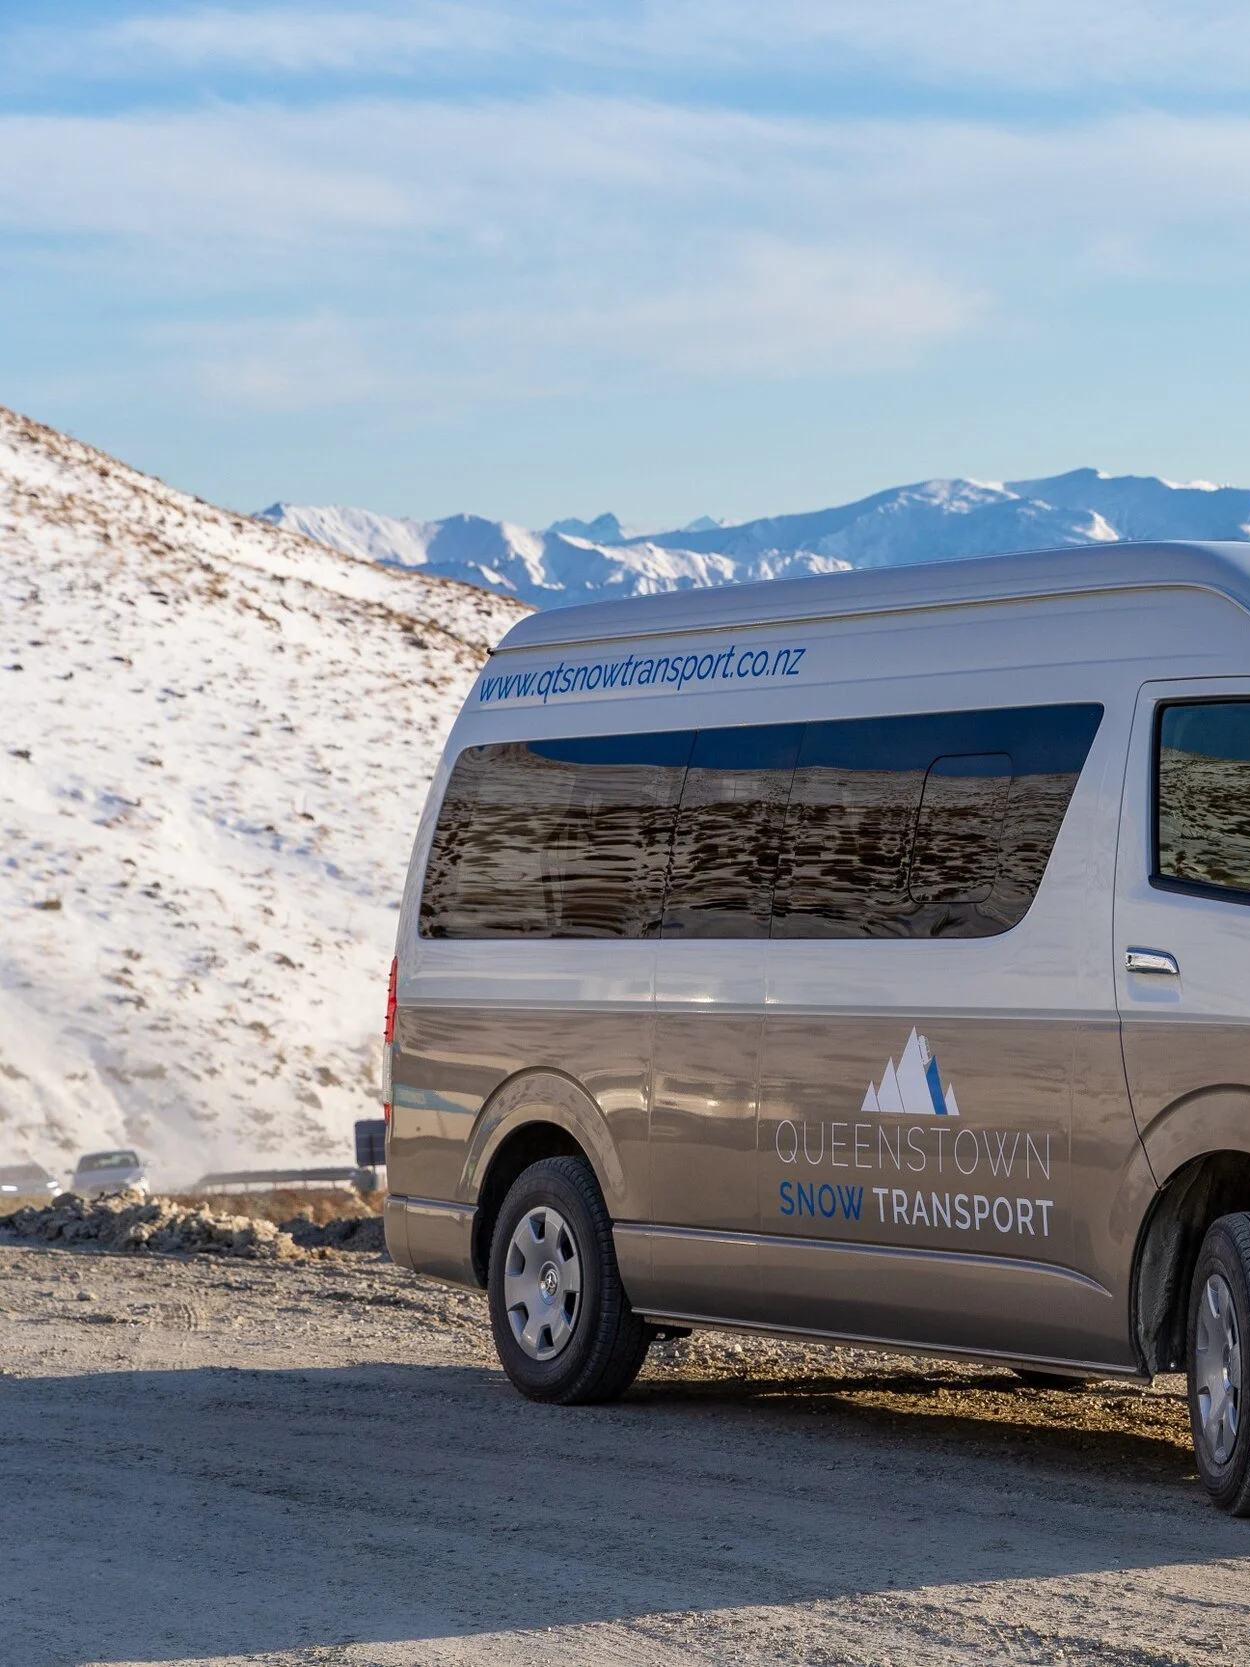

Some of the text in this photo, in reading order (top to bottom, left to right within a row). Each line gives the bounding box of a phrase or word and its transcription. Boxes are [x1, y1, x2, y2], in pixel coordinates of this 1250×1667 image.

[479, 645, 806, 703] www.qtsnowtransport.co.nz
[775, 1119, 1051, 1180] QUEENSTOWN
[779, 1180, 1054, 1237] SNOW TRANSPORT
